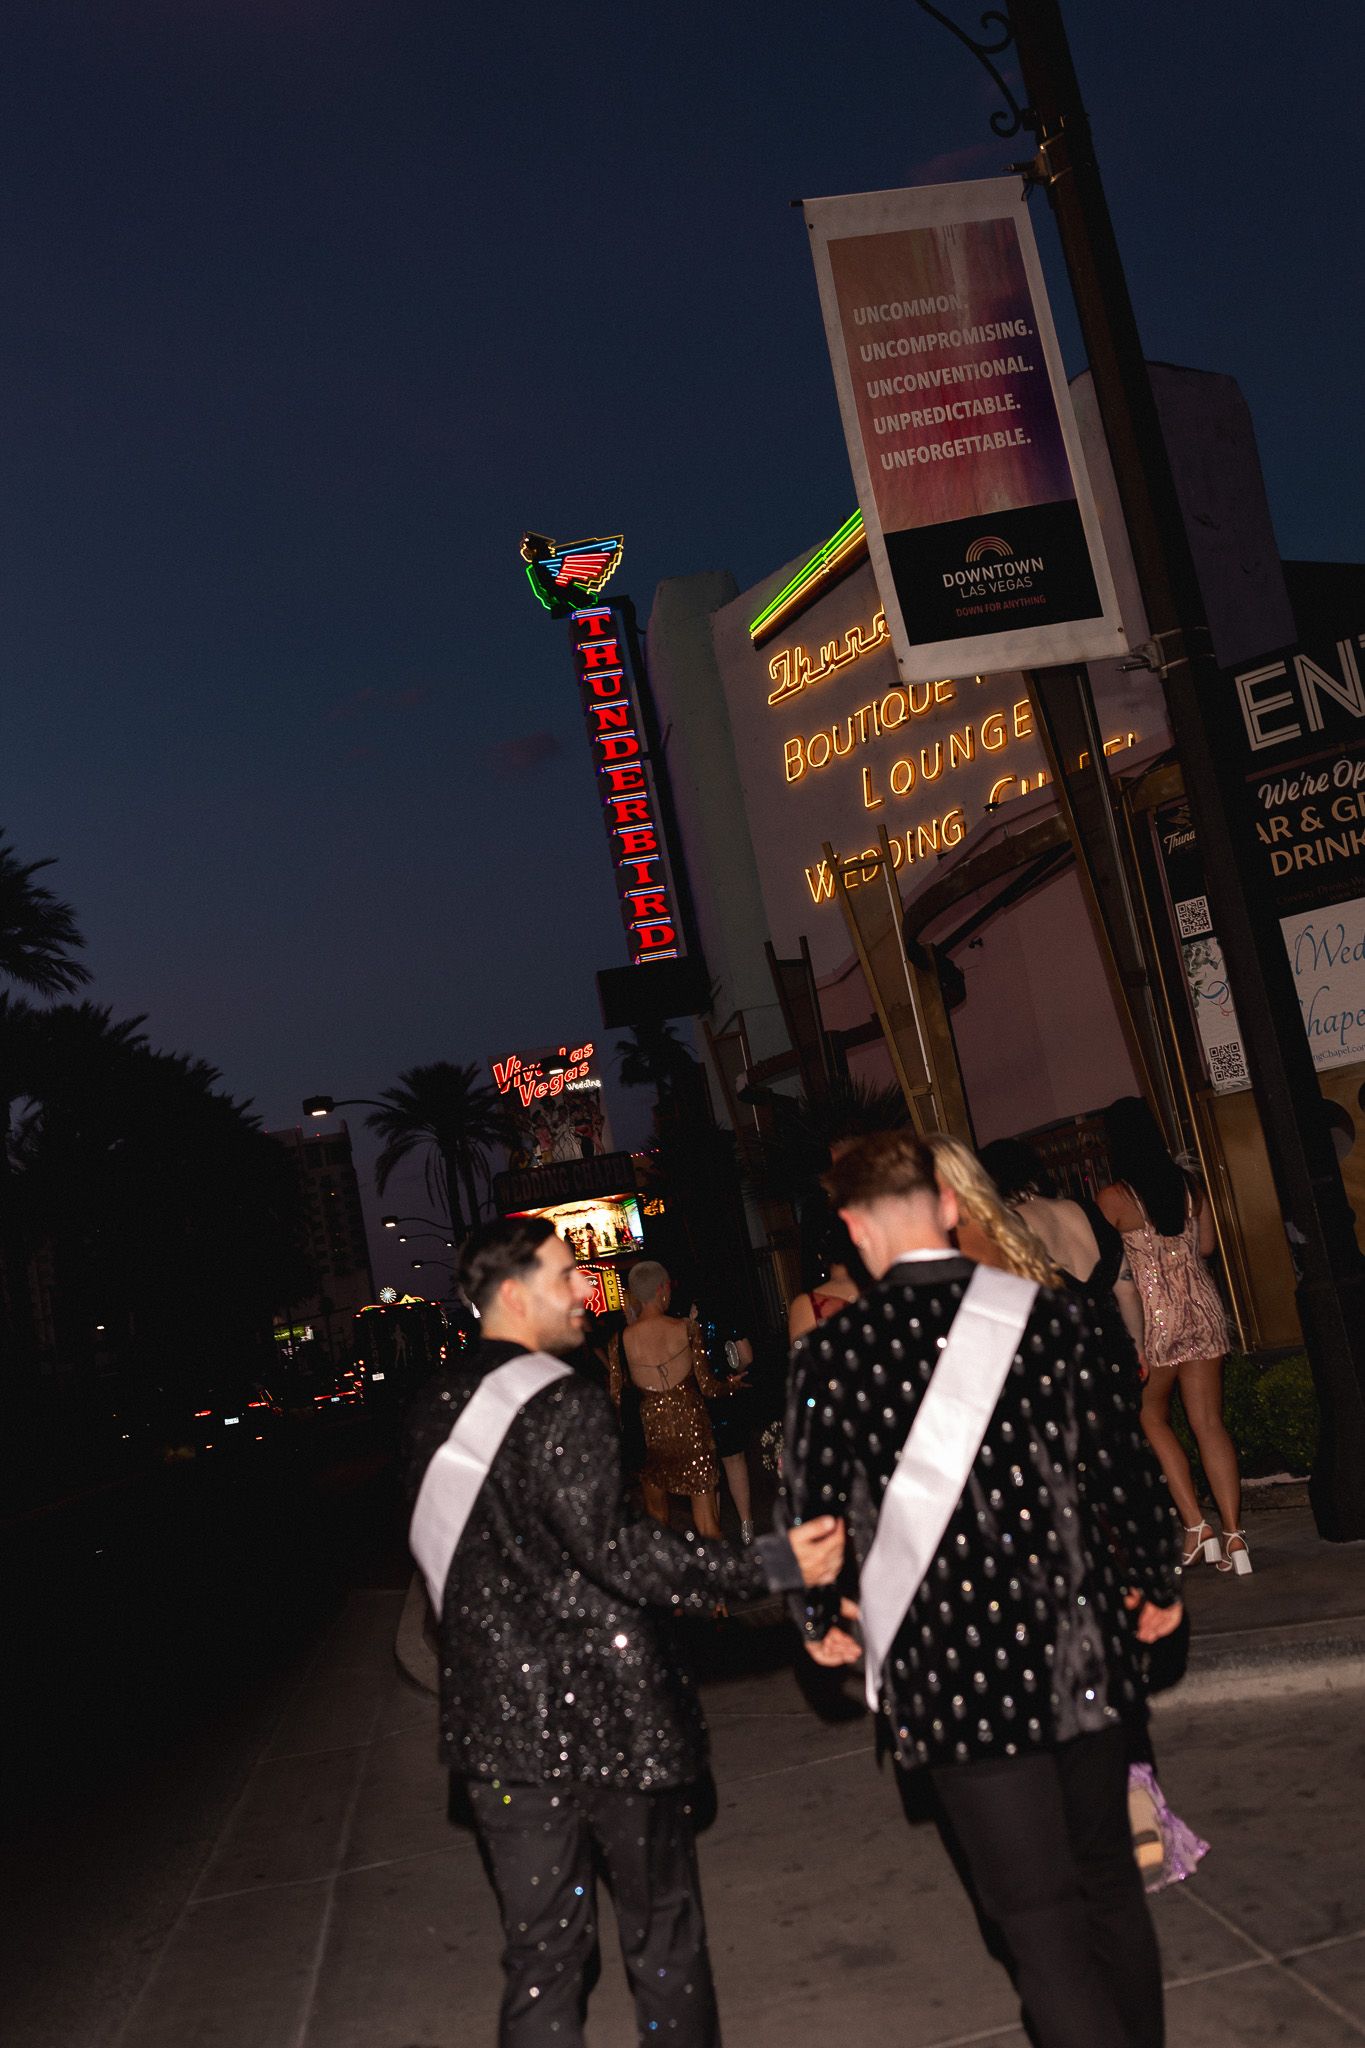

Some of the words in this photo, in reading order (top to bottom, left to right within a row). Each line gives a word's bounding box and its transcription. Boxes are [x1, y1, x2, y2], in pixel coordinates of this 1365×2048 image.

[853, 294, 968, 326] UNCOMMON.
[860, 319, 1033, 362] UNCOMPROMISING.
[867, 355, 1035, 399] UNCONVENTIONAL.
[873, 393, 1022, 434] UNPREDICTABLE.
[880, 427, 1032, 471] UNFORGETTABLE.
[942, 556, 1045, 588] DOWNTOWN
[960, 584, 987, 599] LAS
[988, 576, 1033, 593] VEGAS
[955, 604, 984, 617] DOWN
[984, 600, 1002, 613] FOR
[1003, 594, 1047, 609] ANYTHING
[1234, 633, 1365, 751] EN
[784, 680, 956, 783] BOUTIQUE
[862, 699, 1033, 809] LOUNGE
[578, 614, 675, 949] THUNDERBIRD
[1257, 770, 1330, 809] We're
[1300, 805, 1326, 833] &
[519, 1061, 590, 1107] Vegas
[606, 1271, 618, 1309] HOTEL
